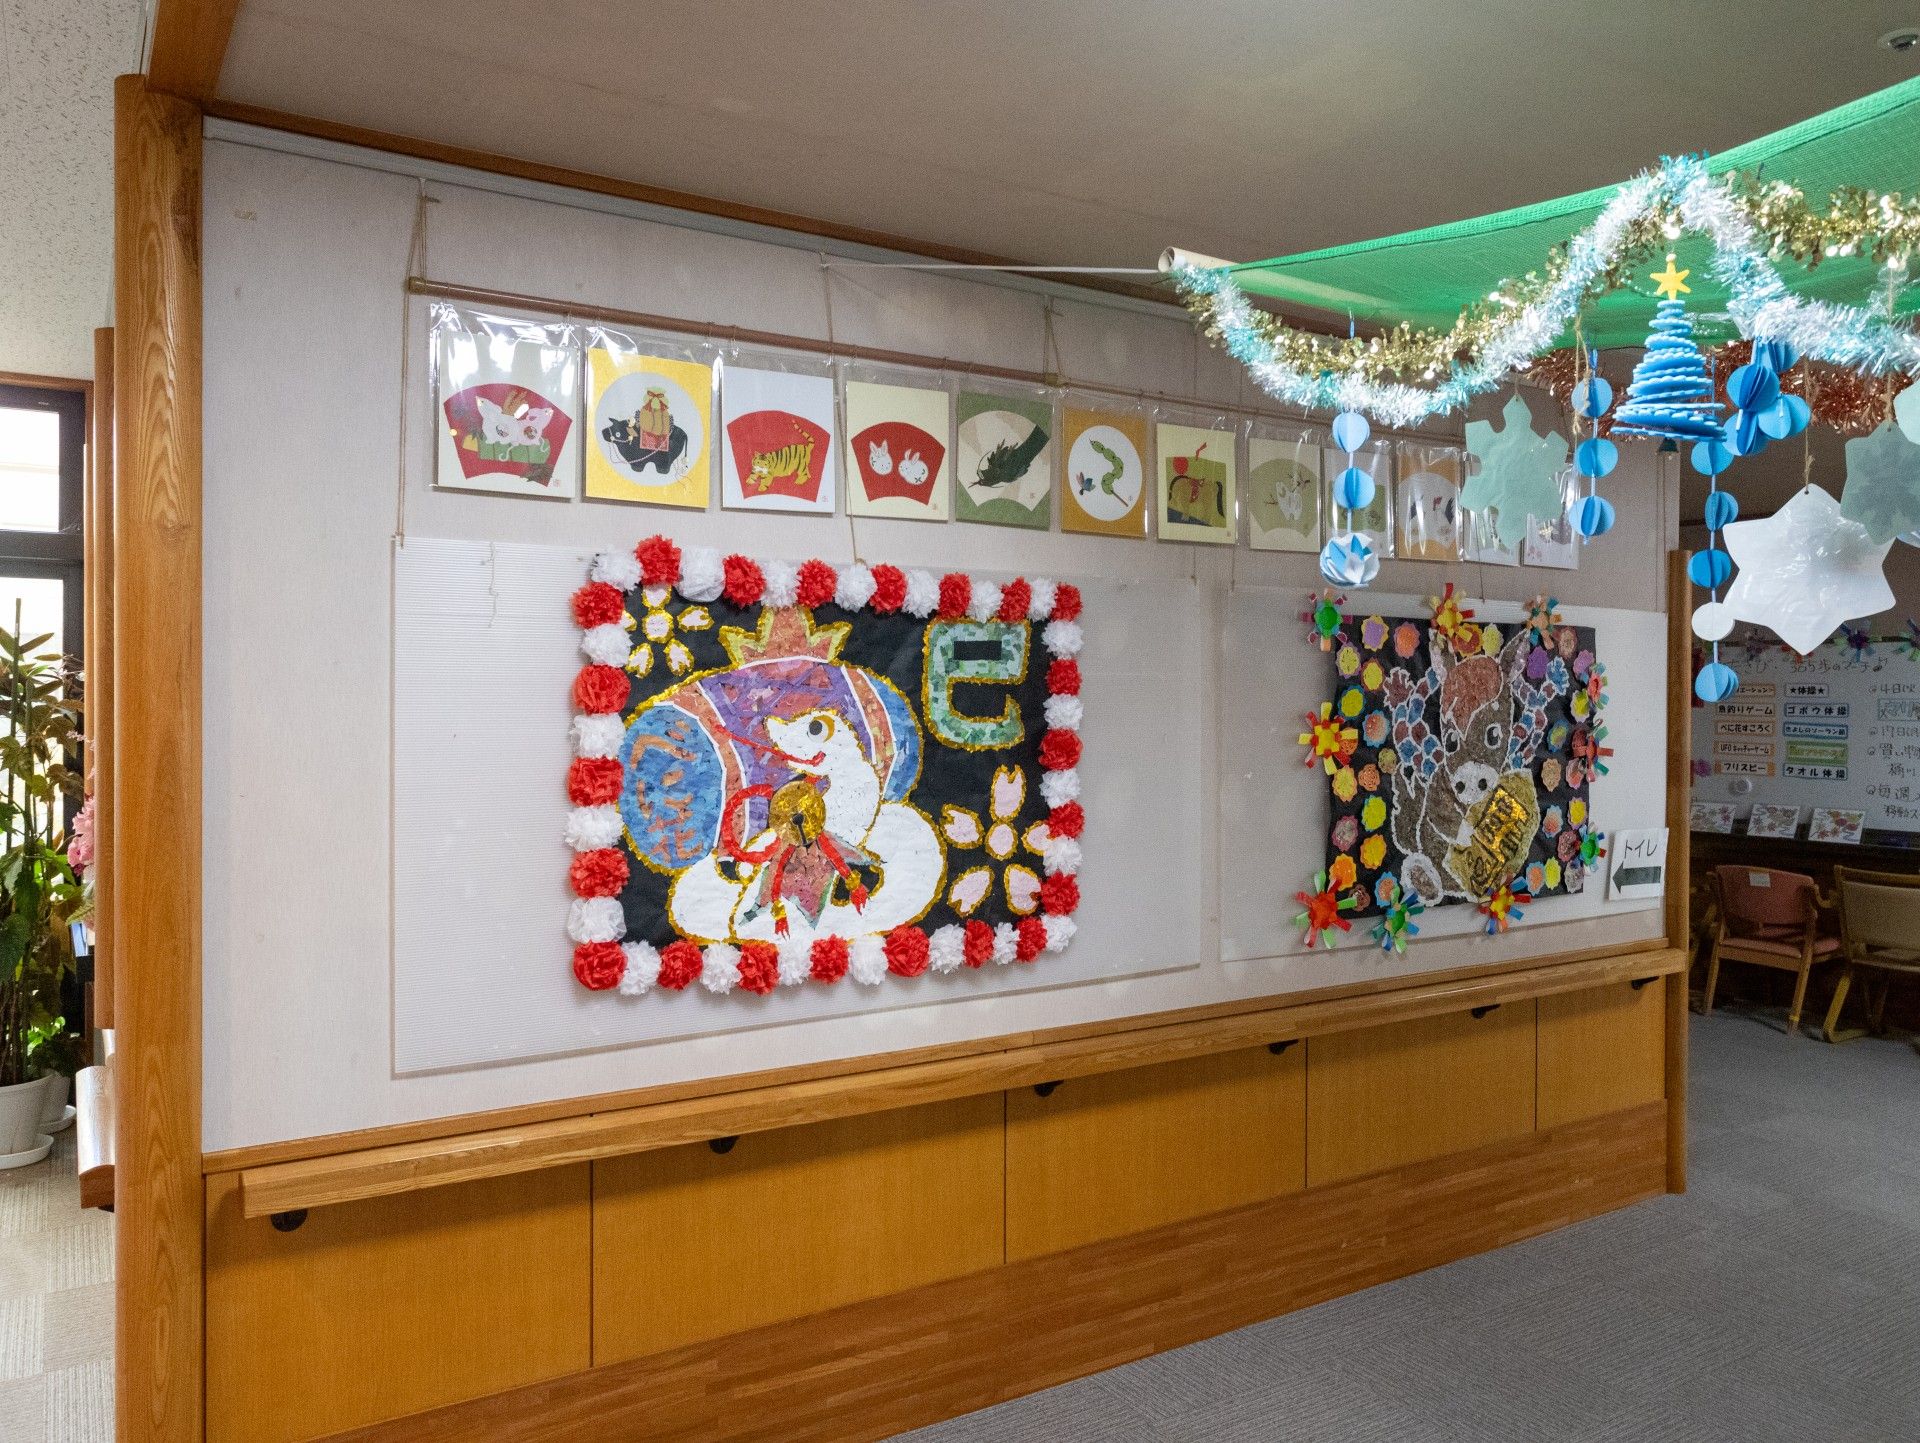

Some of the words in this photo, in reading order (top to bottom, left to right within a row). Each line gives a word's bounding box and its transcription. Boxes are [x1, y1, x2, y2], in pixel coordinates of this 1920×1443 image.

[1786, 766, 1846, 779] タオル体操
[1624, 839, 1658, 859] トイレ
